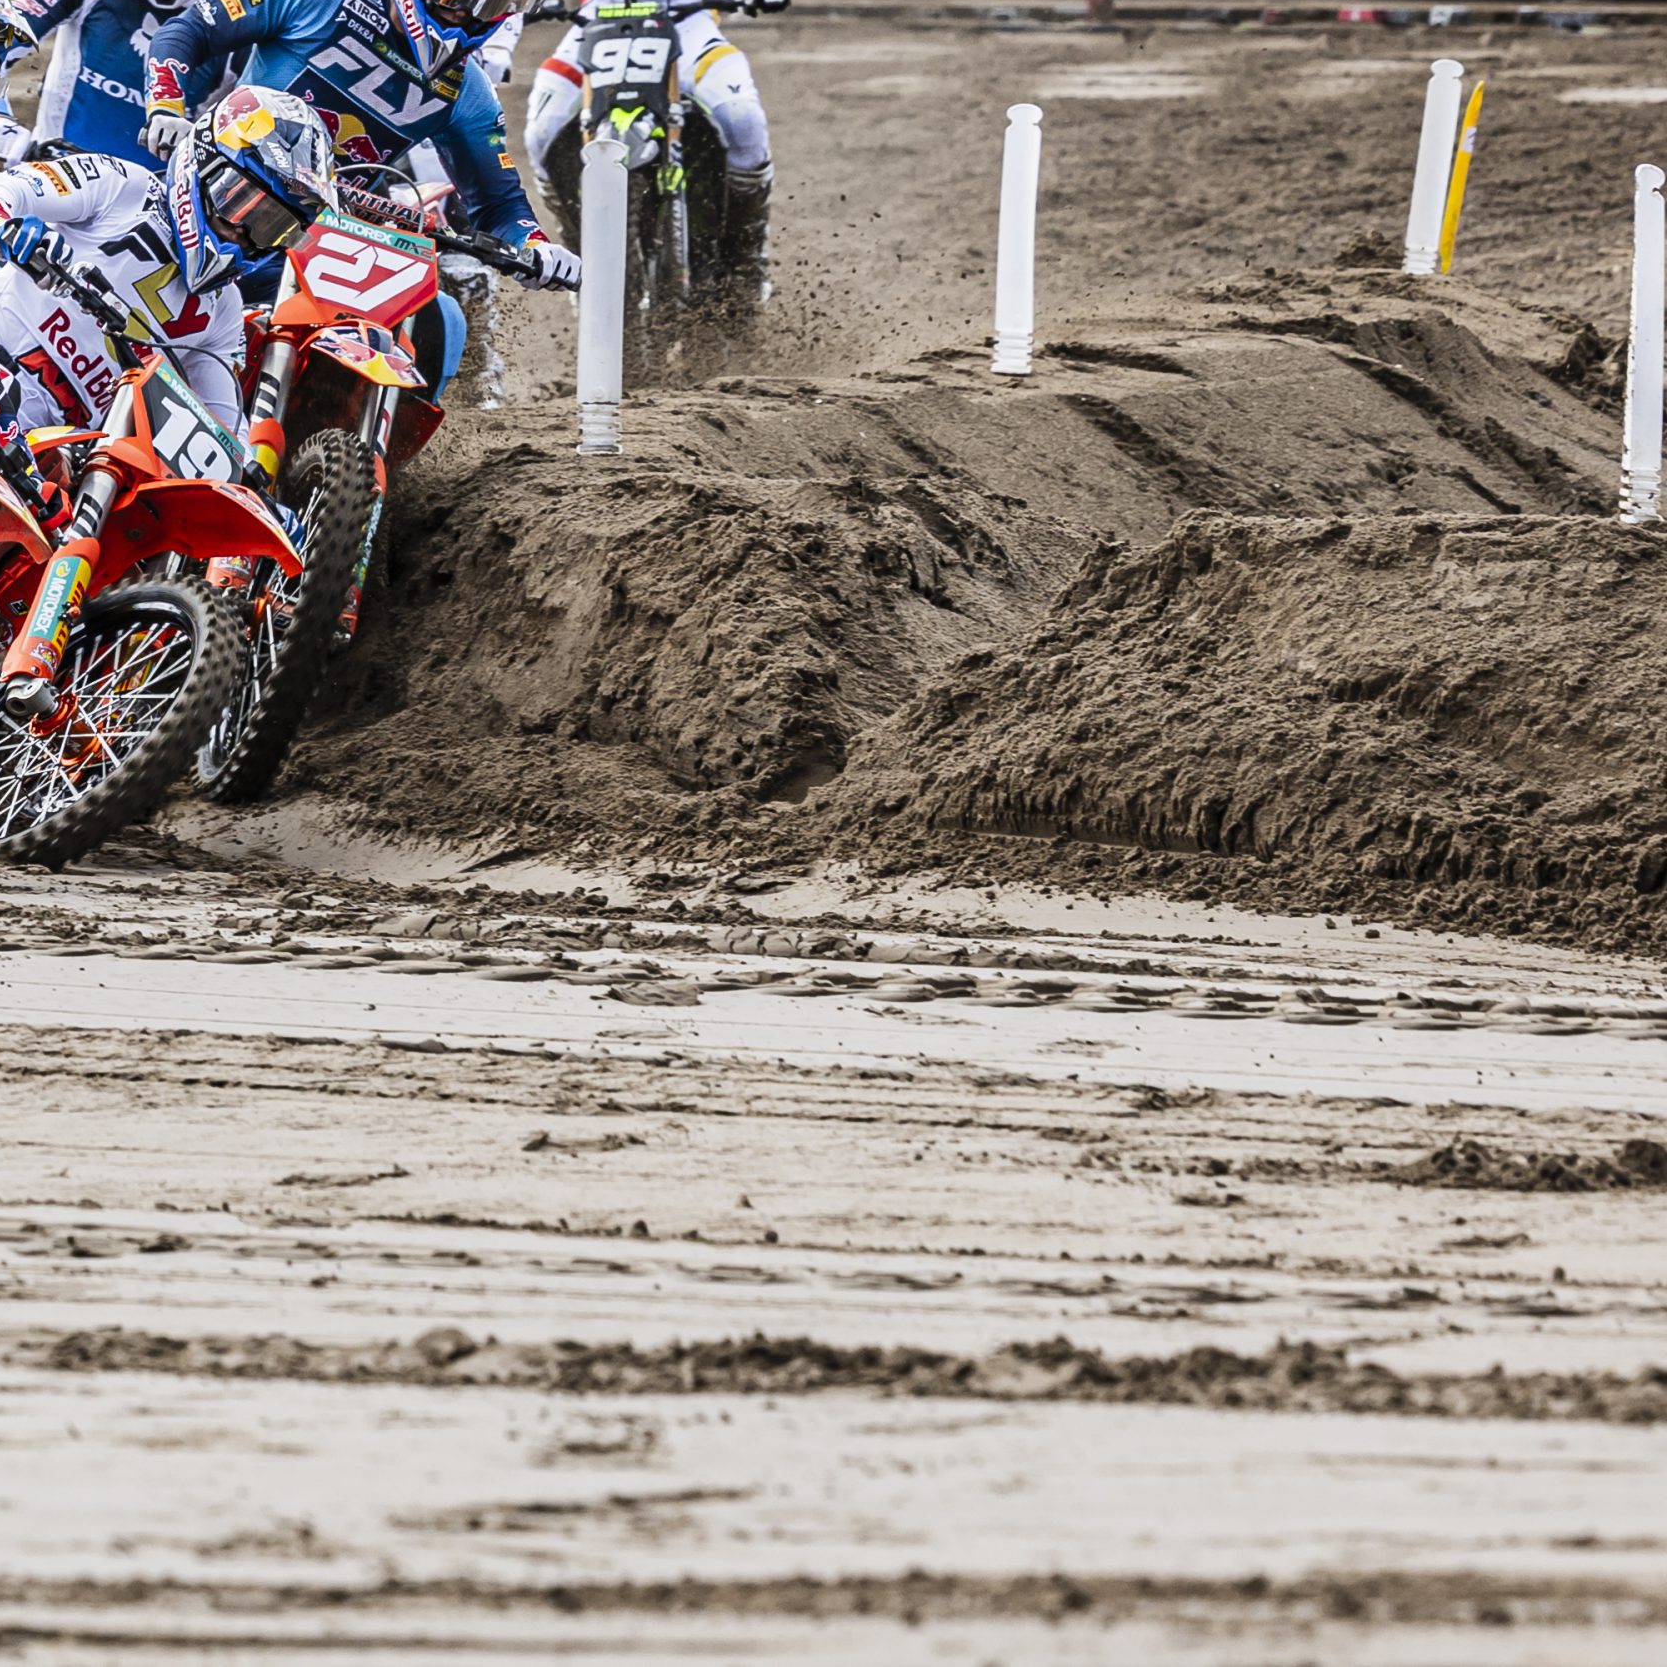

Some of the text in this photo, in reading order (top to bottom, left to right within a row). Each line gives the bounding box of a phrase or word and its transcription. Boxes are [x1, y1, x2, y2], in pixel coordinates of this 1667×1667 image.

[348, 19, 374, 44] DEKRA
[308, 35, 448, 127] FLY
[386, 50, 424, 81] MOTOREX
[590, 37, 672, 88] 99
[266, 139, 291, 170] AIROH
[176, 199, 199, 250] Bull
[324, 215, 395, 246] MOTOREX
[303, 231, 430, 313] 27
[37, 306, 104, 380] Red
[170, 378, 219, 433] MOTOREX
[153, 396, 233, 484] 19
[31, 575, 67, 636] MOTOREX
